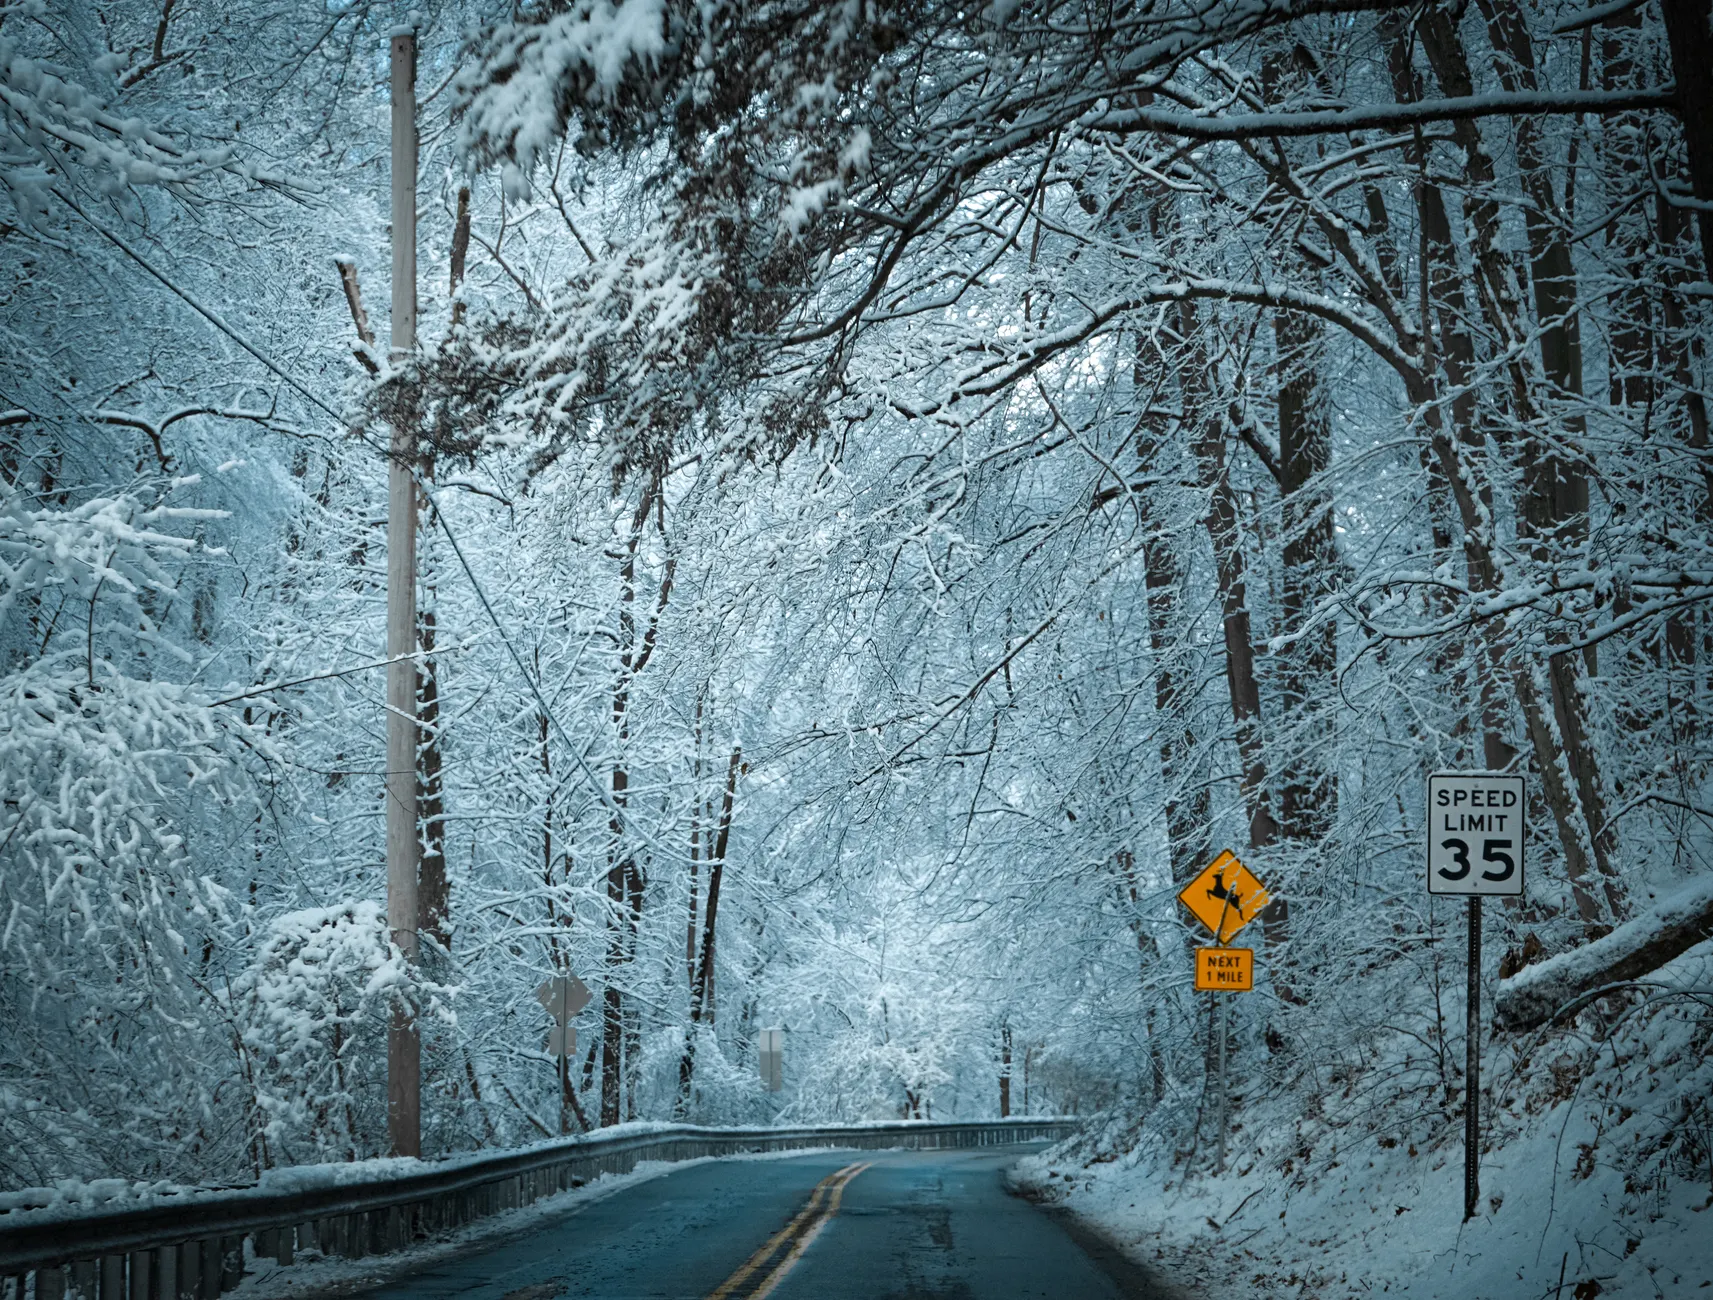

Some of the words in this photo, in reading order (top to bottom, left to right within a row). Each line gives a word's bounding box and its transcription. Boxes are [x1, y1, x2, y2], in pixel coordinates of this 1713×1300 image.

[1437, 789, 1517, 807] SPEED
[1444, 814, 1508, 832] LIMIT
[1437, 838, 1515, 882] 35
[1207, 956, 1241, 967] NEXT
[1207, 971, 1212, 981] 1
[1217, 971, 1243, 982] MILE
